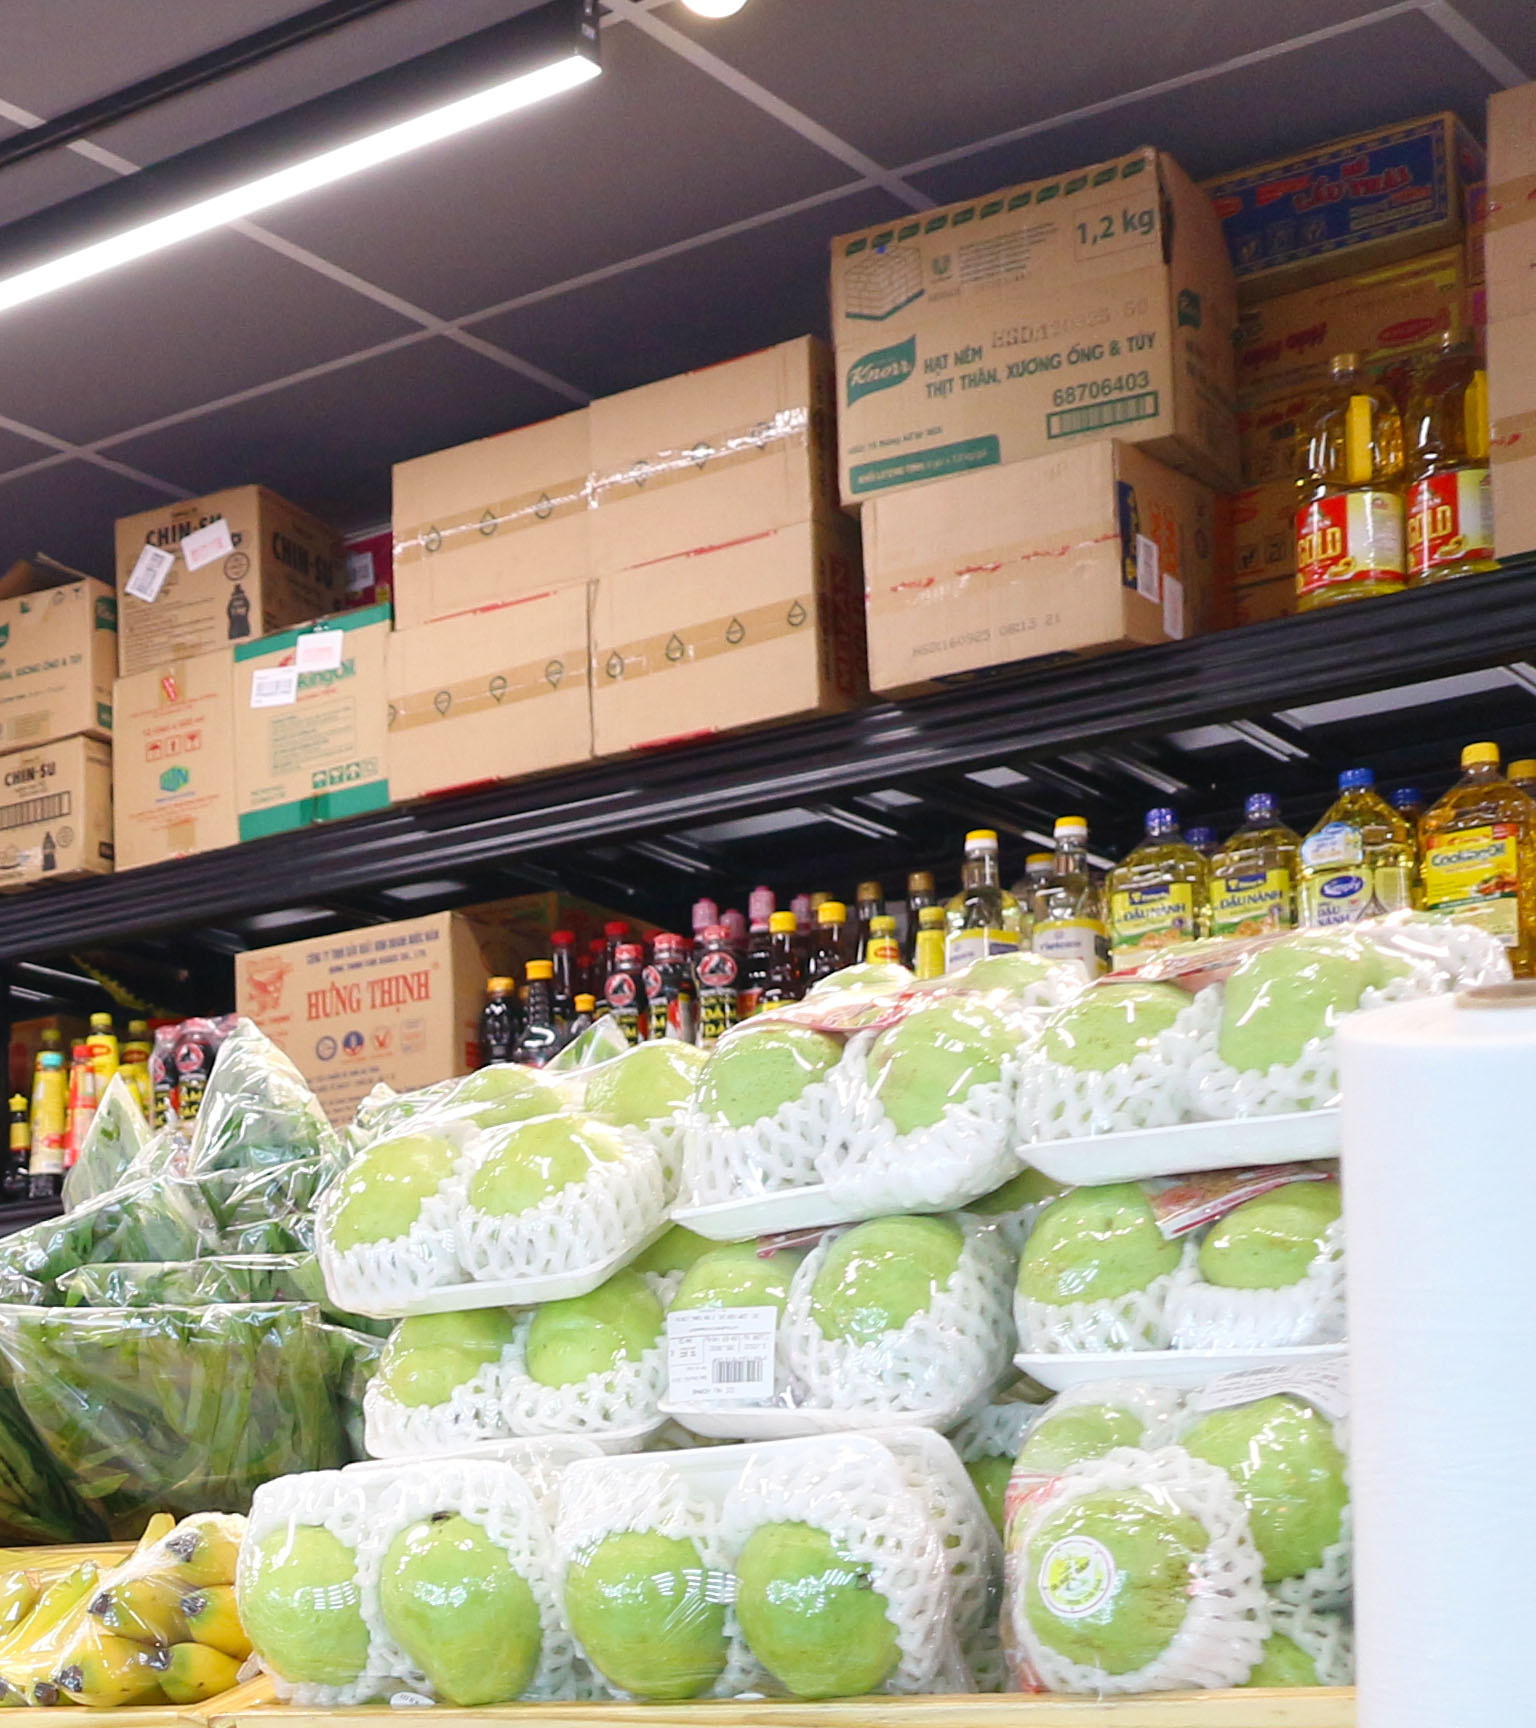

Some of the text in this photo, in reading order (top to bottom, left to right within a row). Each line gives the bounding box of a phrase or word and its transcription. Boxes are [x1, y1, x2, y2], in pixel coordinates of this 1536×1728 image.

[1076, 208, 1155, 246] 1,2 kg
[1109, 339, 1121, 357] &
[850, 357, 913, 387] Knorr
[1052, 371, 1150, 407] 68706403
[1408, 504, 1452, 546] GOLD
[1297, 526, 1342, 569] GOLD
[4, 760, 57, 789] CHIN-SU
[306, 967, 432, 1021] HƯNG THỊNH
